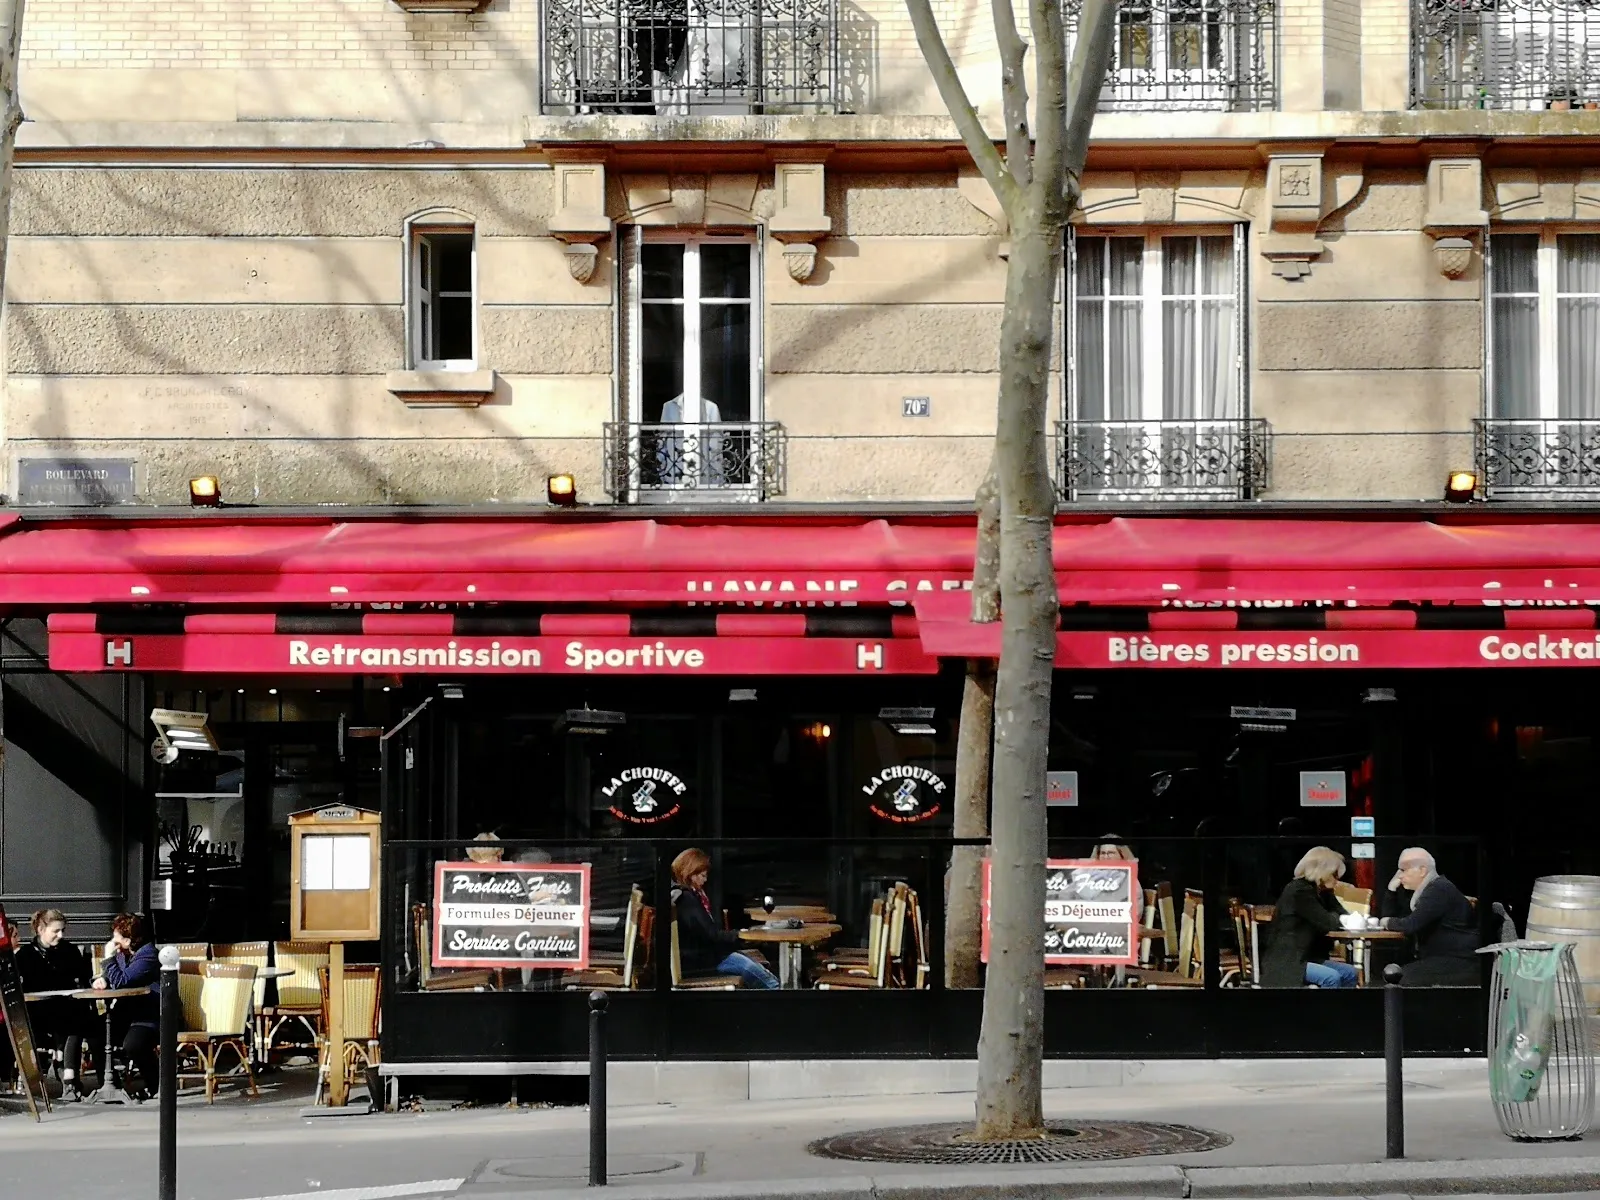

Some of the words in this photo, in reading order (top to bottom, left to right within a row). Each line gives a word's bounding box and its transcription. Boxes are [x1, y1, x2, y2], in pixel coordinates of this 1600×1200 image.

[45, 469, 109, 480] BOULEVARD
[107, 641, 131, 665] H
[289, 640, 541, 667] Retransmission
[565, 641, 704, 670] Sportive
[858, 644, 882, 669] H
[1108, 636, 1210, 662] Bières
[1221, 636, 1359, 665] pression
[1479, 634, 1600, 660] Cocktai
[602, 777, 623, 797] LA
[621, 766, 687, 796] CHOUFFE
[862, 776, 883, 796] LA
[881, 765, 946, 794] CHOUFFE
[452, 875, 521, 894] Produits
[1074, 873, 1119, 893] Frais
[448, 907, 511, 919] Formules
[514, 908, 576, 923] Déjeuner
[1062, 904, 1124, 919] Déjeuner
[449, 929, 510, 951] Service
[514, 931, 577, 951] Continu
[1063, 927, 1125, 948] Continu
